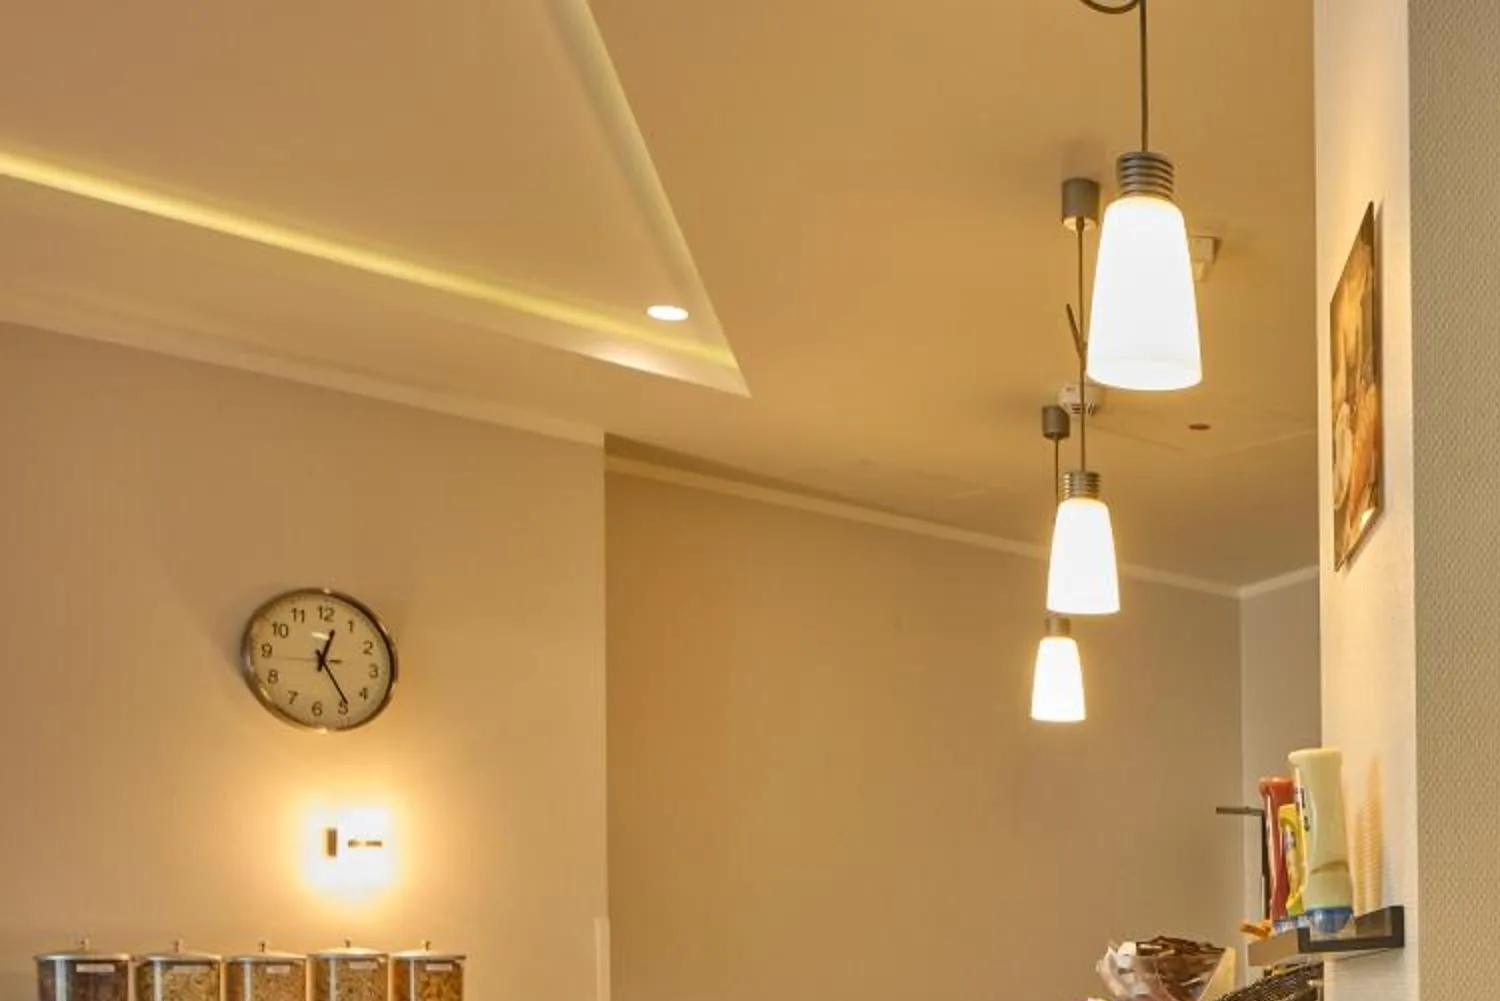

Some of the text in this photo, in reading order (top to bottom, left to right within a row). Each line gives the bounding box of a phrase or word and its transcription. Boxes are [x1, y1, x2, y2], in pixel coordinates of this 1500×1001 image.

[291, 608, 306, 624] 11
[317, 605, 335, 622] 12
[271, 622, 289, 639] 10
[261, 643, 273, 659] 9
[362, 640, 373, 656] 2
[267, 670, 279, 685] 8
[368, 664, 379, 679] 3
[287, 691, 298, 705] 7
[359, 687, 368, 700] 4
[311, 701, 323, 717] 6
[337, 700, 349, 715] 5
